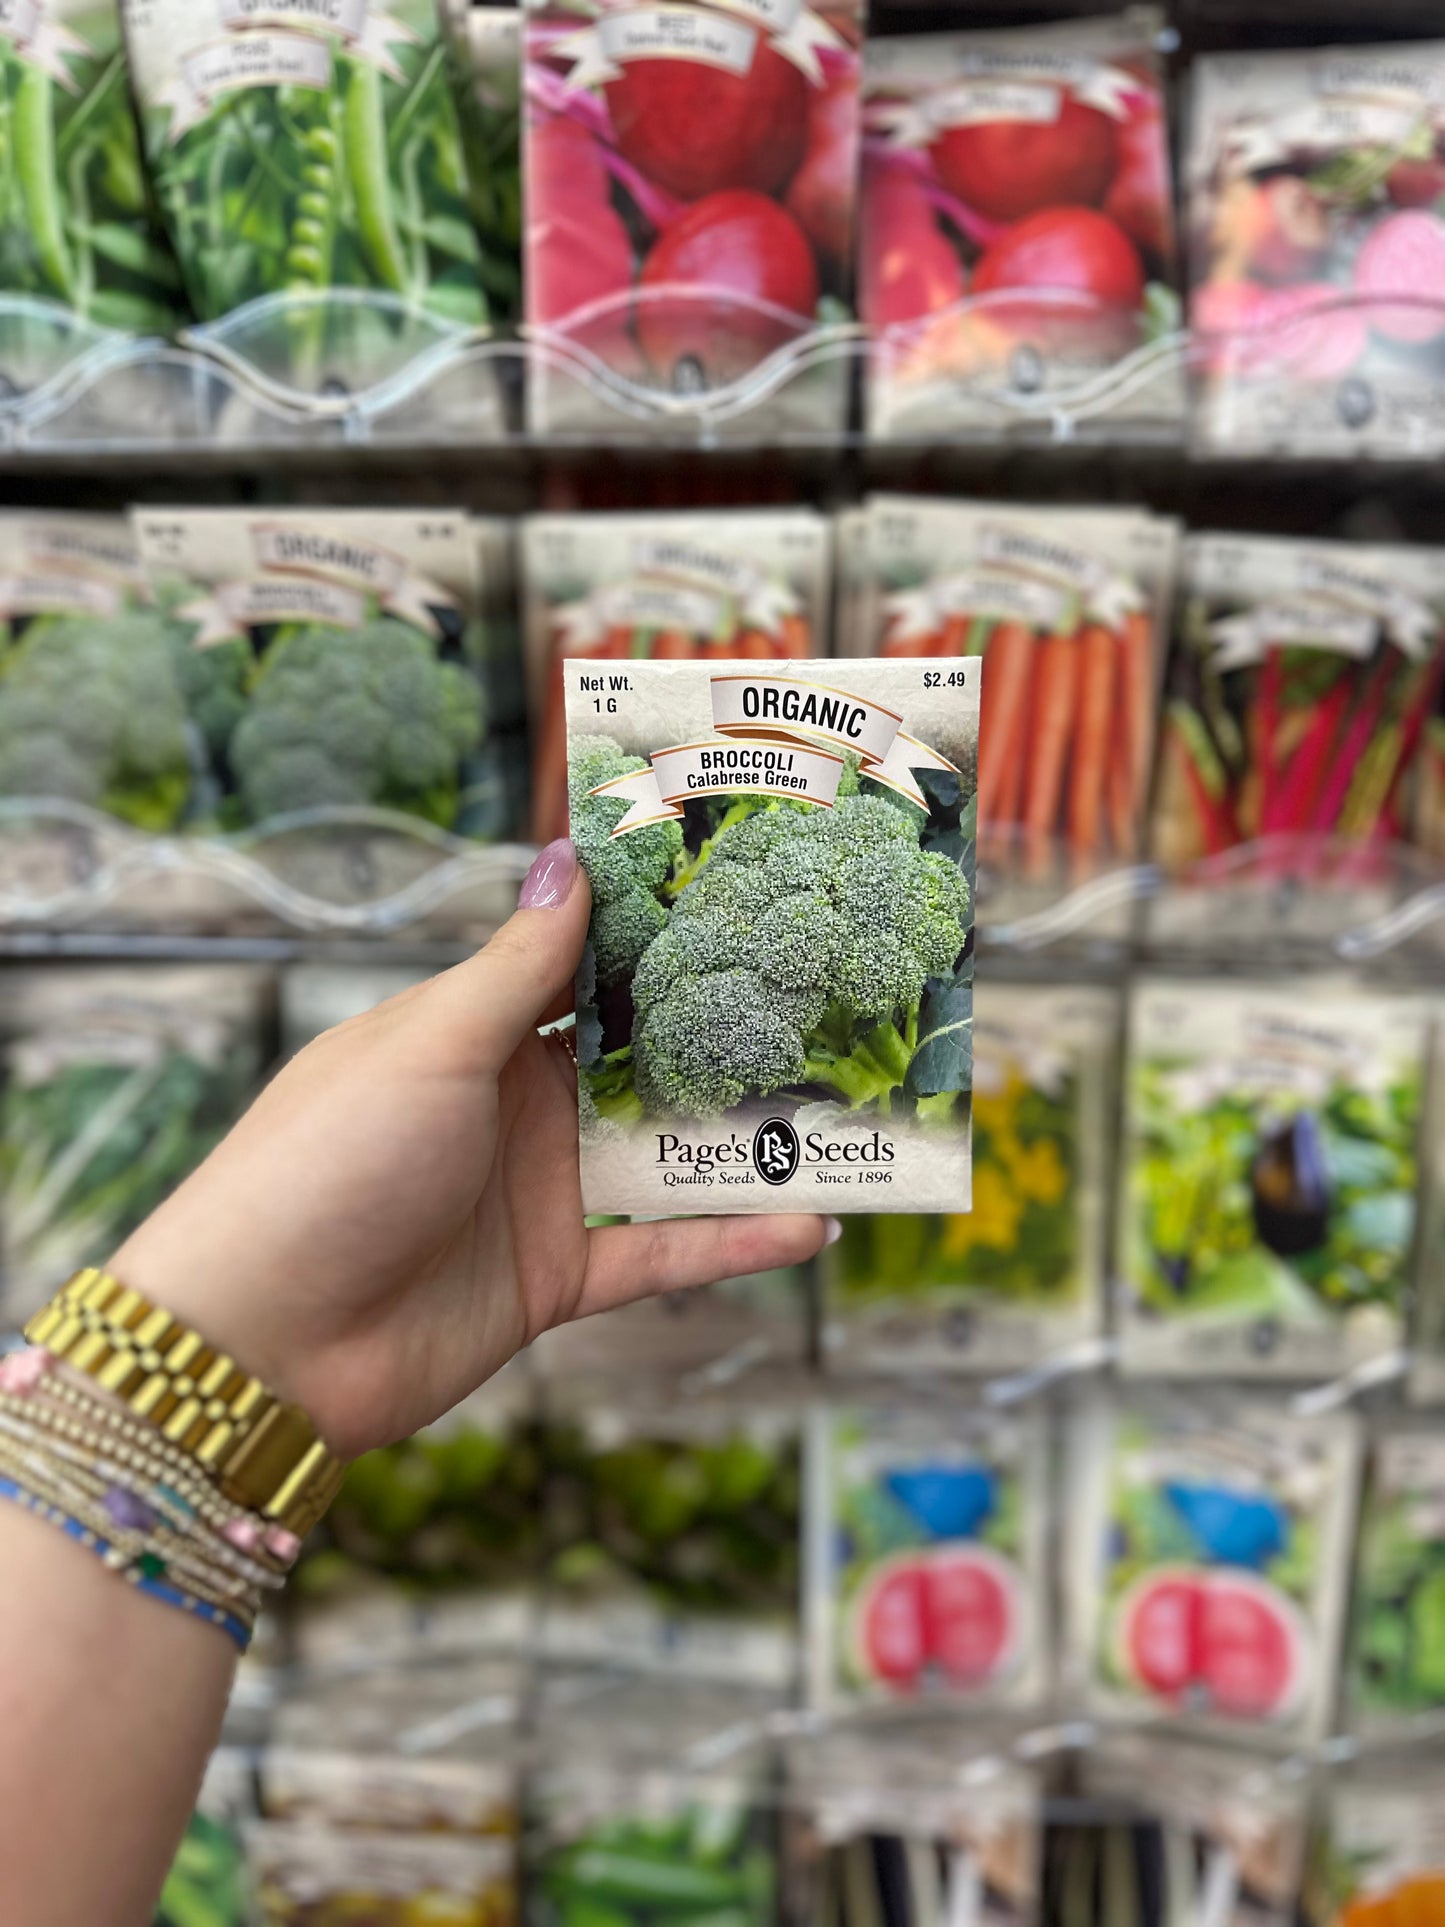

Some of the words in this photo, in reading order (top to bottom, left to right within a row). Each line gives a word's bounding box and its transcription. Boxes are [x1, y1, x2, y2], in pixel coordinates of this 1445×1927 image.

[580, 676, 605, 691] Net
[608, 675, 634, 691] Wt.
[923, 671, 965, 689] $2.49
[593, 698, 600, 713] 1
[606, 697, 617, 713] G
[741, 686, 867, 739] ORGANIC
[700, 750, 794, 772] BROCCOLI
[686, 770, 760, 789] Calabrese
[764, 770, 808, 790] Green
[655, 1133, 749, 1173] Page's
[805, 1131, 895, 1162] Seeds
[663, 1171, 715, 1187] Quality
[718, 1171, 756, 1185] Seeds
[815, 1171, 852, 1185] Since
[857, 1170, 893, 1184] 1896
